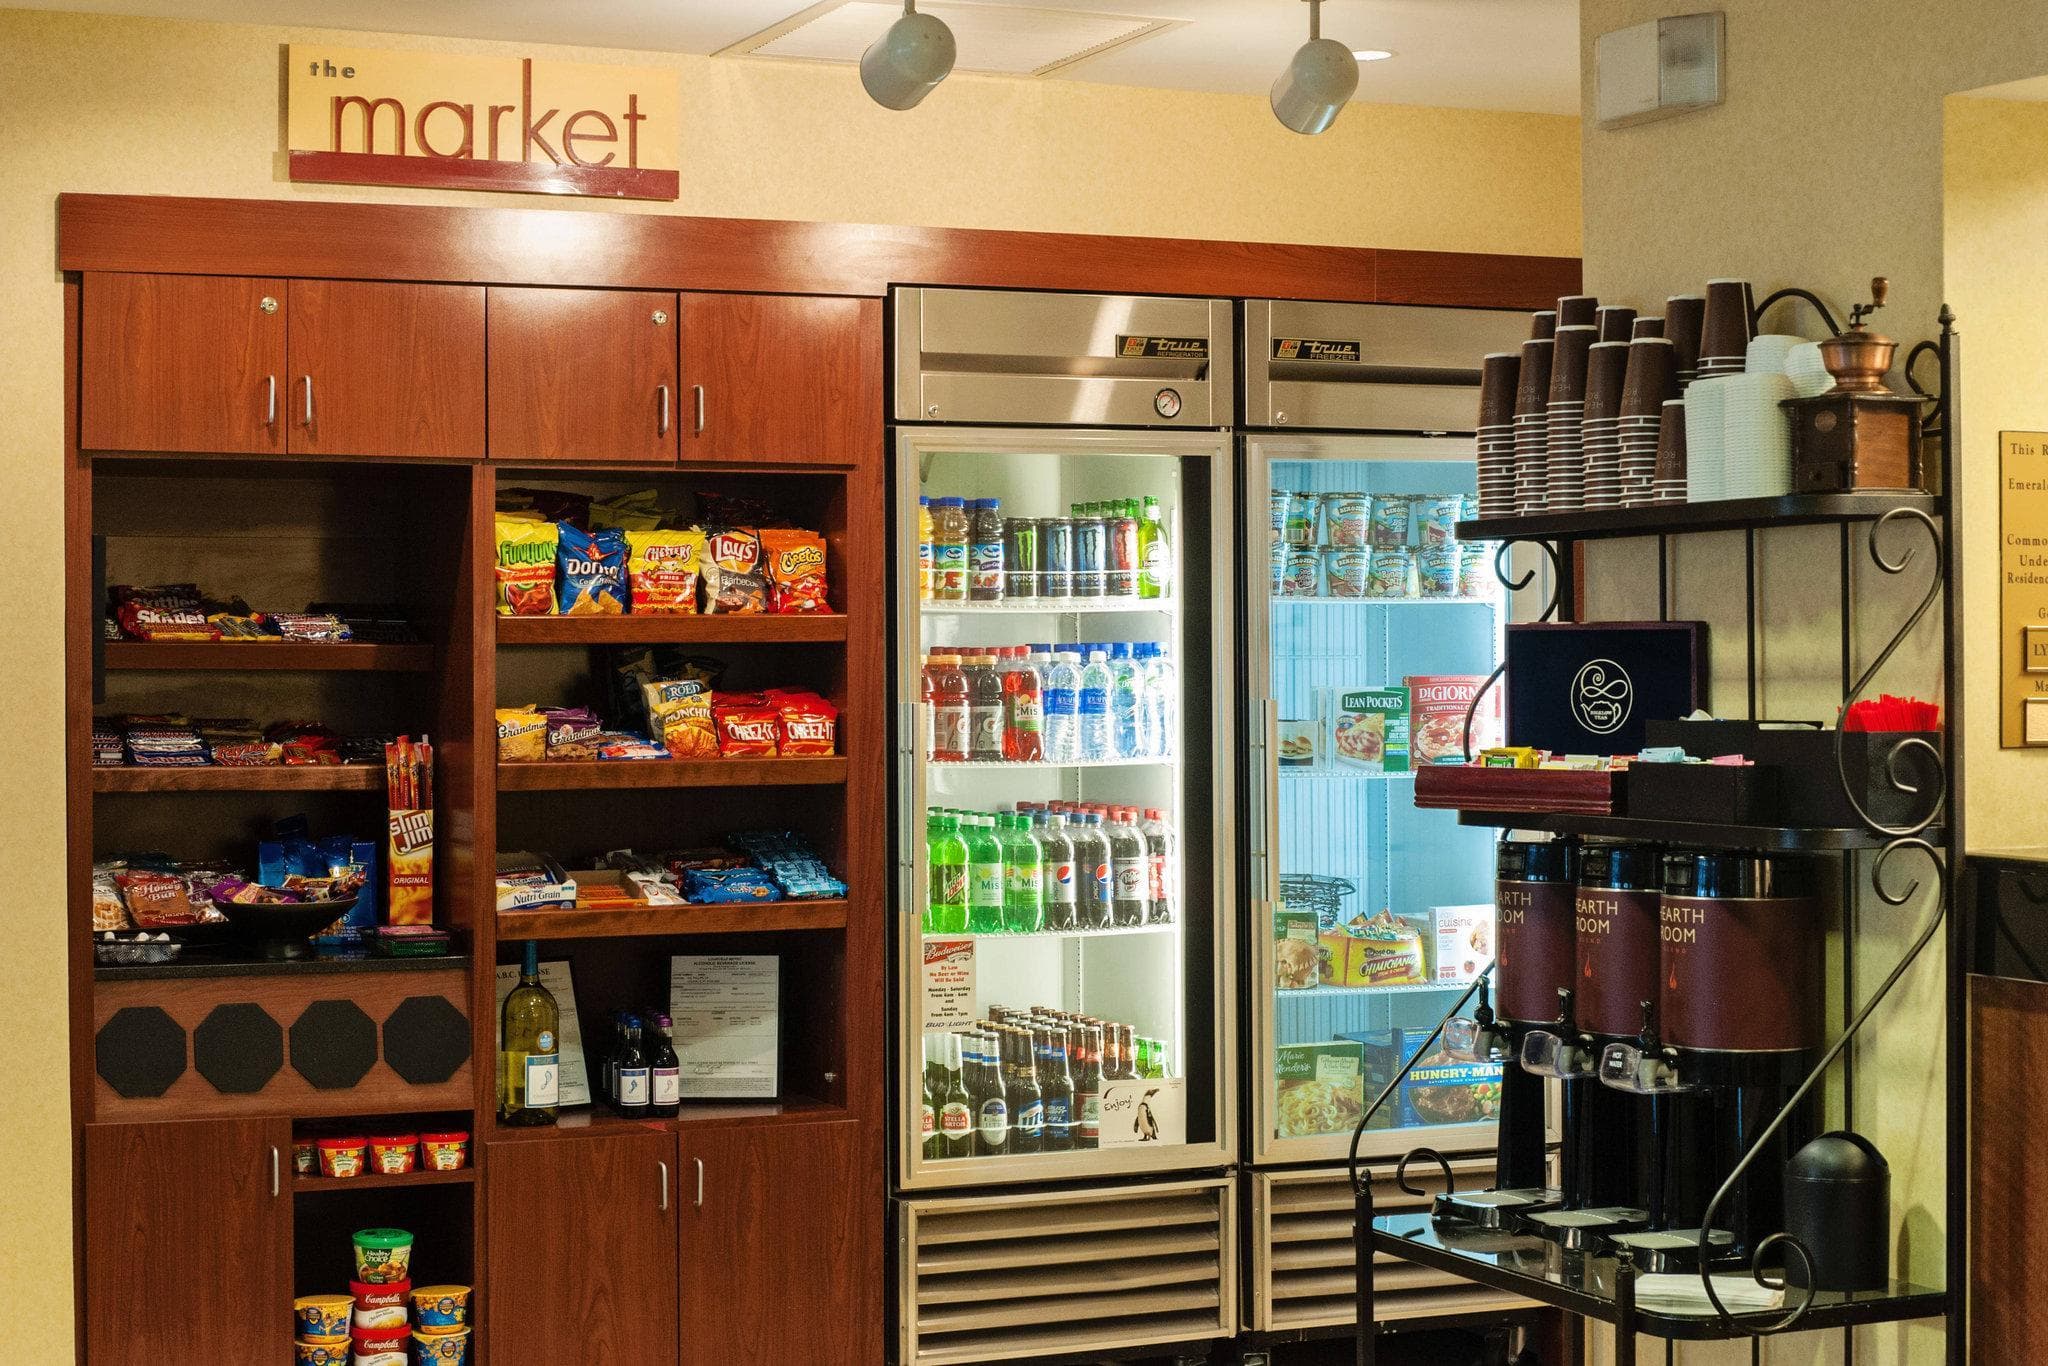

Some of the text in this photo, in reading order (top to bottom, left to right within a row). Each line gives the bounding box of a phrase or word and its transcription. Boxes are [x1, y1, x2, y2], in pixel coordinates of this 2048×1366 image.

[310, 59, 355, 79] the
[333, 58, 647, 170] market
[1151, 339, 1204, 351] true
[1304, 341, 1356, 354] true
[1310, 353, 1356, 361] FREEZER
[2011, 443, 2034, 456] This
[715, 538, 756, 561] Lay's
[136, 609, 206, 625] Skittles
[669, 683, 700, 696] ROLD
[1419, 686, 1479, 702] DIGIORN
[1345, 695, 1403, 708] LEAN POCKETS
[727, 722, 775, 741] CHEEZ-IT
[786, 721, 834, 741] CHEEZ-IT
[141, 882, 181, 895] Honey
[149, 891, 177, 902] Bun
[1439, 917, 1472, 928] cuisine
[926, 943, 972, 960] Budweiser
[1104, 1095, 1133, 1112] Enjoy!
[364, 1255, 389, 1264] Choice
